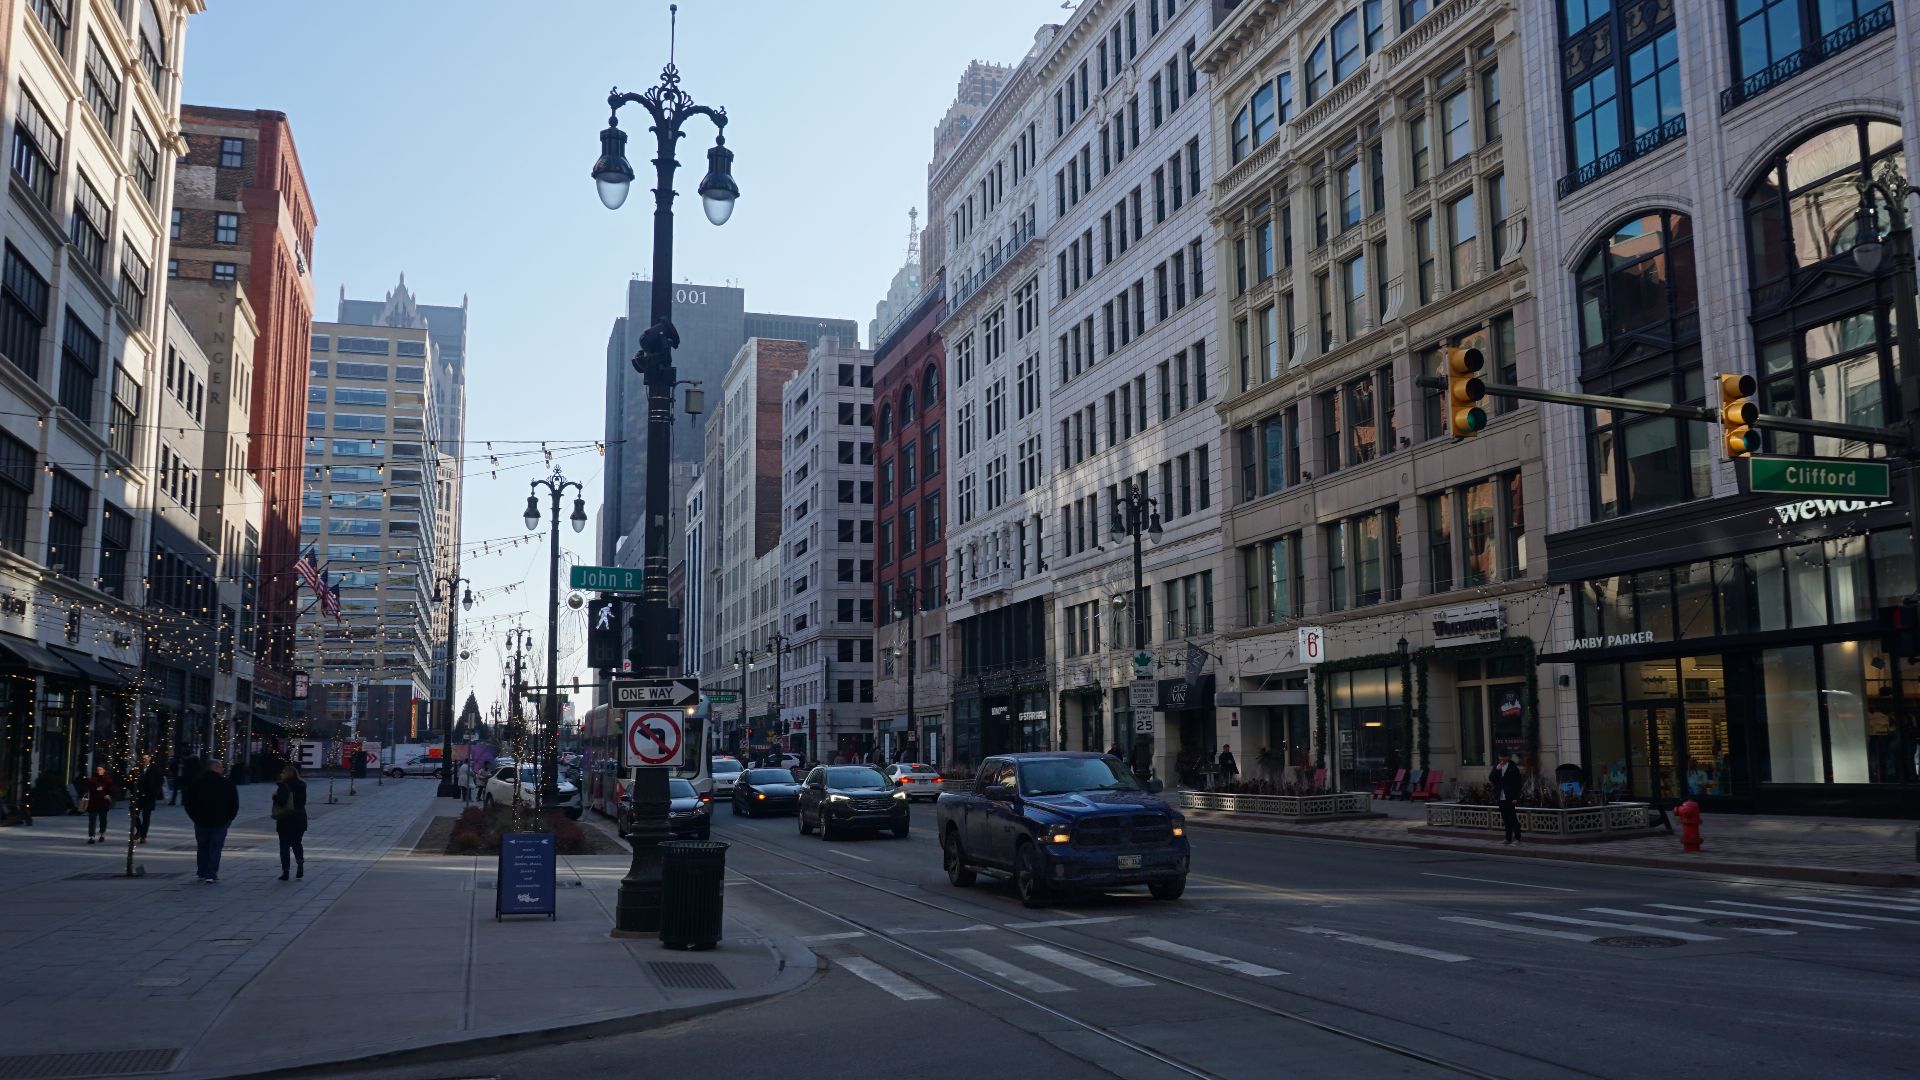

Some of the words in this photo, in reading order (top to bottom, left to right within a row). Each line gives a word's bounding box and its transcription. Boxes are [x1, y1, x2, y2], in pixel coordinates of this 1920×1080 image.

[672, 289, 708, 305] 001
[210, 293, 225, 404] SINGER
[1786, 467, 1856, 486] Clifford
[1774, 498, 1895, 524] wewo
[581, 570, 617, 587] John
[624, 572, 634, 588] R
[1565, 637, 1603, 651] WARBY
[1608, 631, 1654, 647] PARKER
[624, 663, 631, 671] P
[621, 688, 646, 700] ONE
[649, 687, 674, 700] WAY
[1136, 720, 1153, 731] 25
